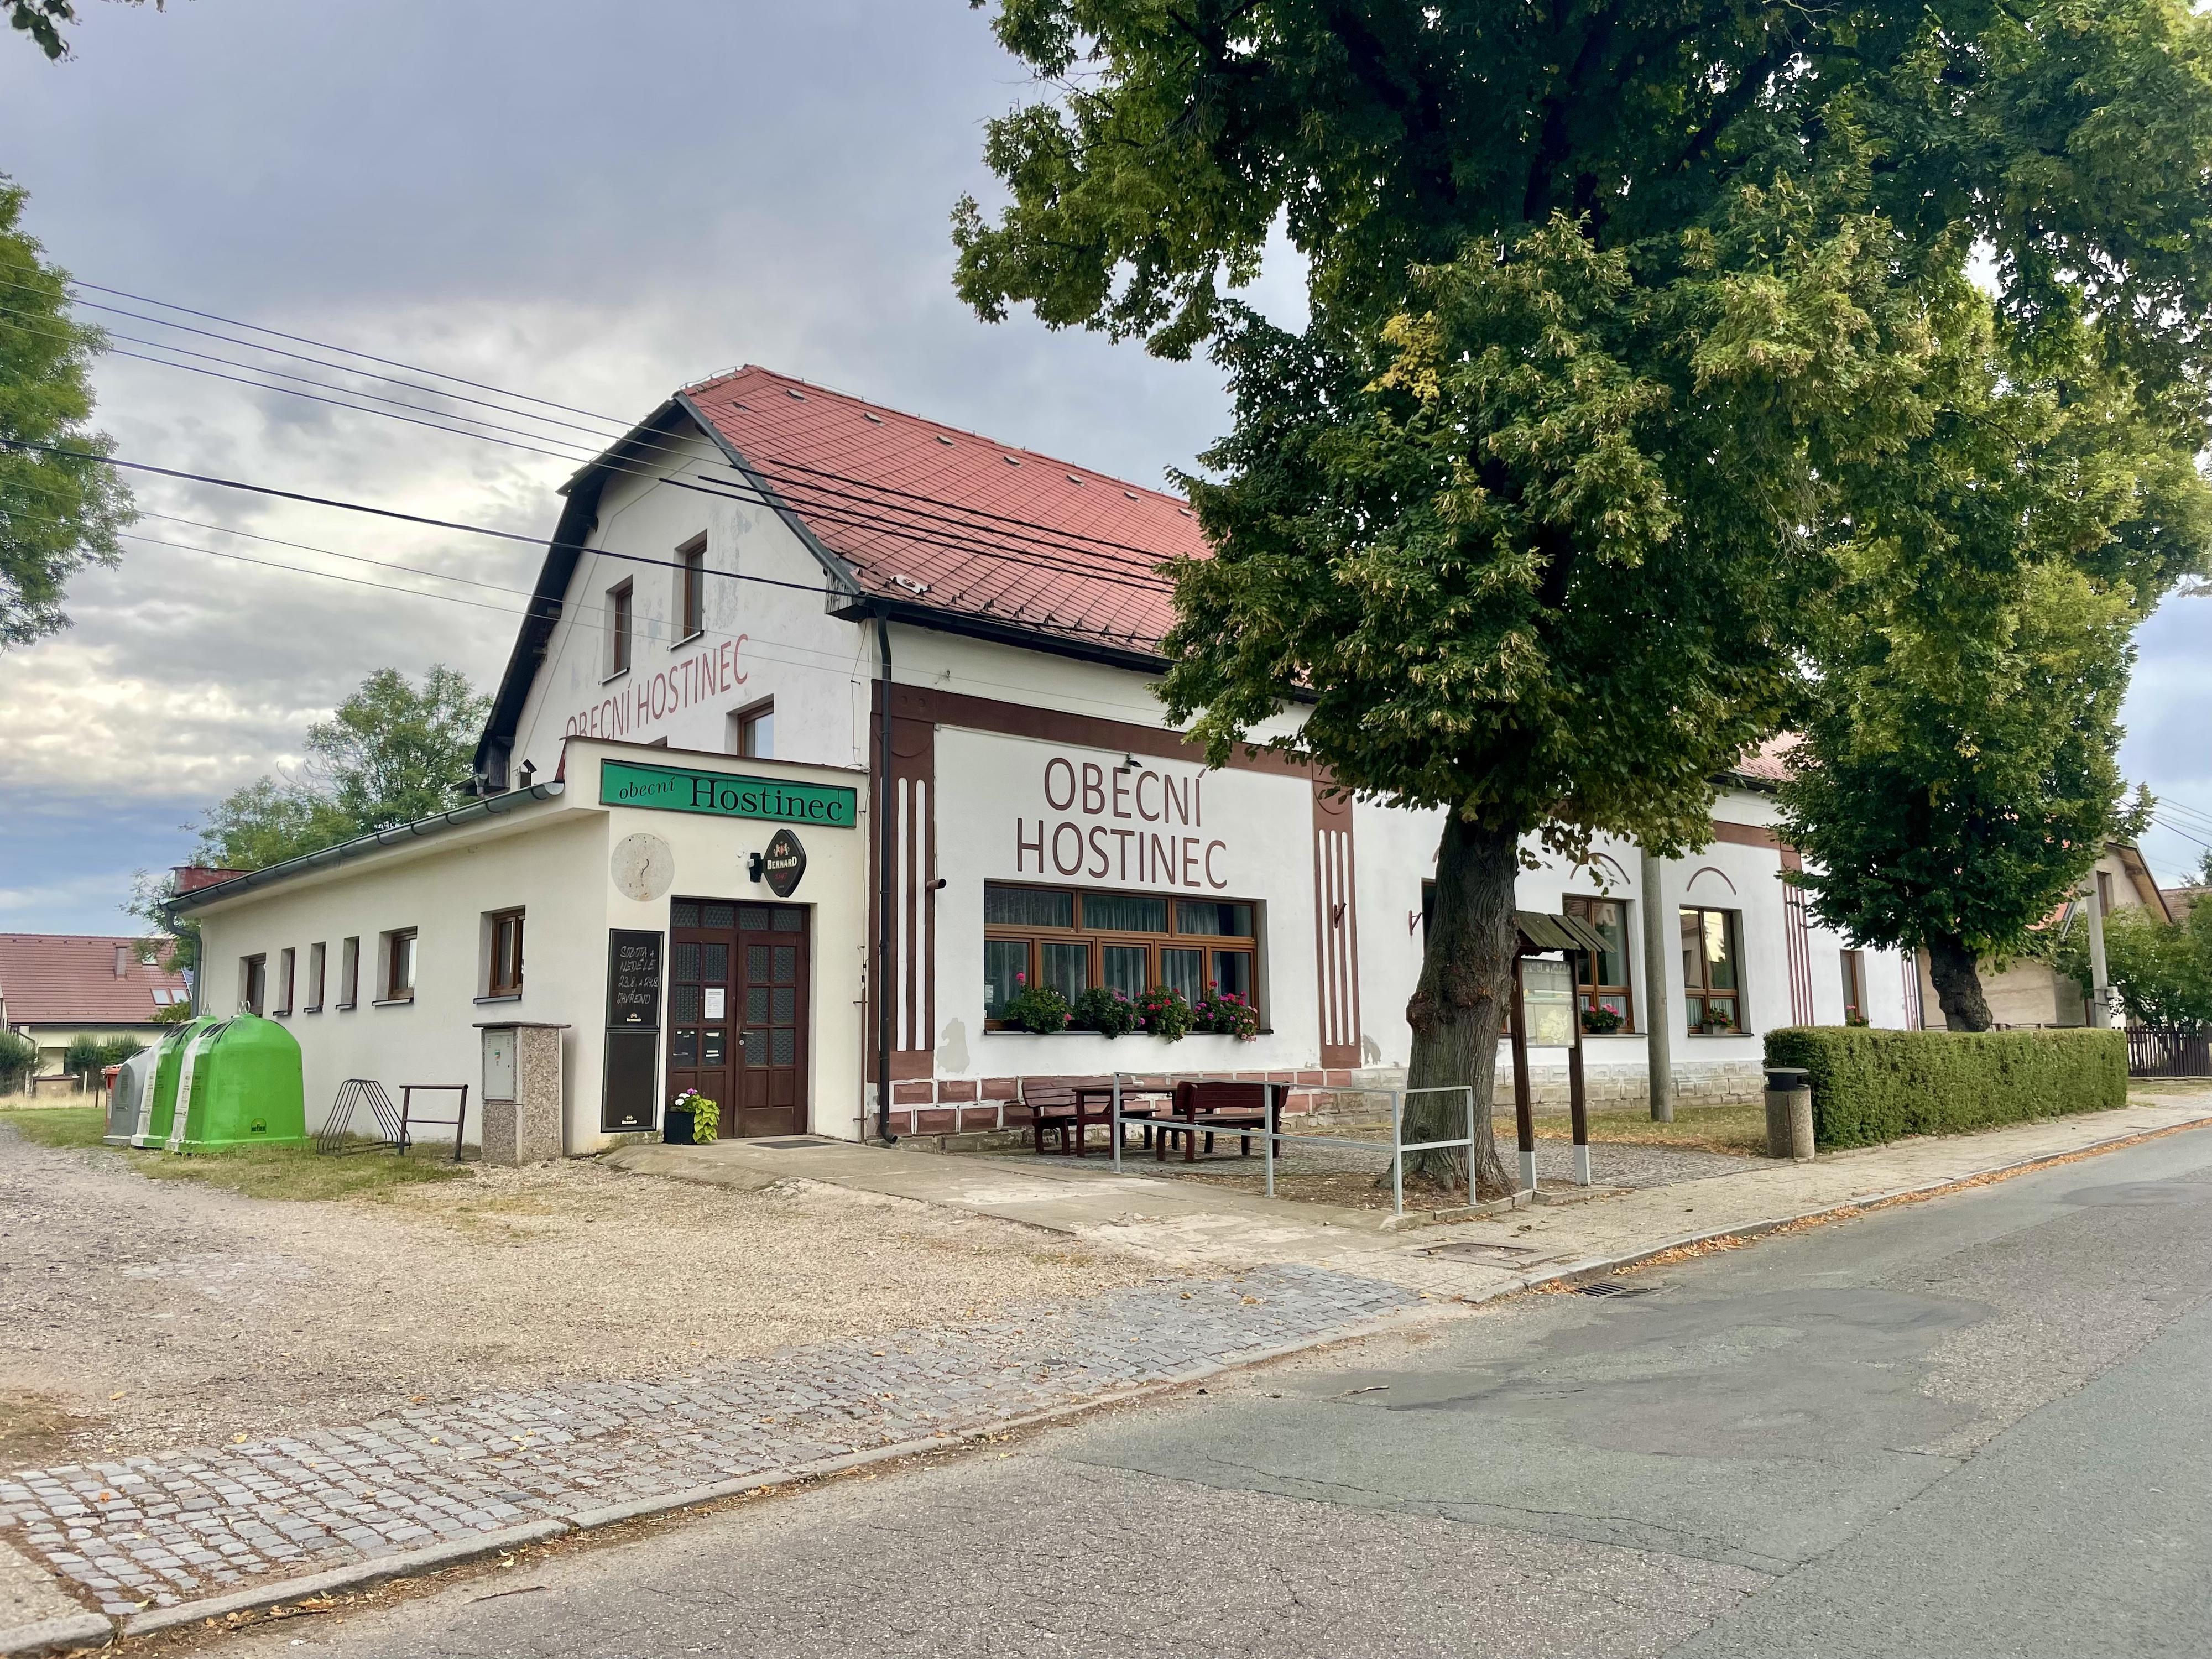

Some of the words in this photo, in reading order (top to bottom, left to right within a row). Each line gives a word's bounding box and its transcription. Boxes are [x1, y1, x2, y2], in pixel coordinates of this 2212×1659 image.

[637, 634, 748, 728] HOSTINEC
[619, 776, 675, 800] obecní
[690, 778, 843, 822] Hostinec
[1044, 757, 1206, 827] OBECNÍ
[767, 856, 797, 869] BERNARD
[1017, 817, 1227, 889] HOSTINEC
